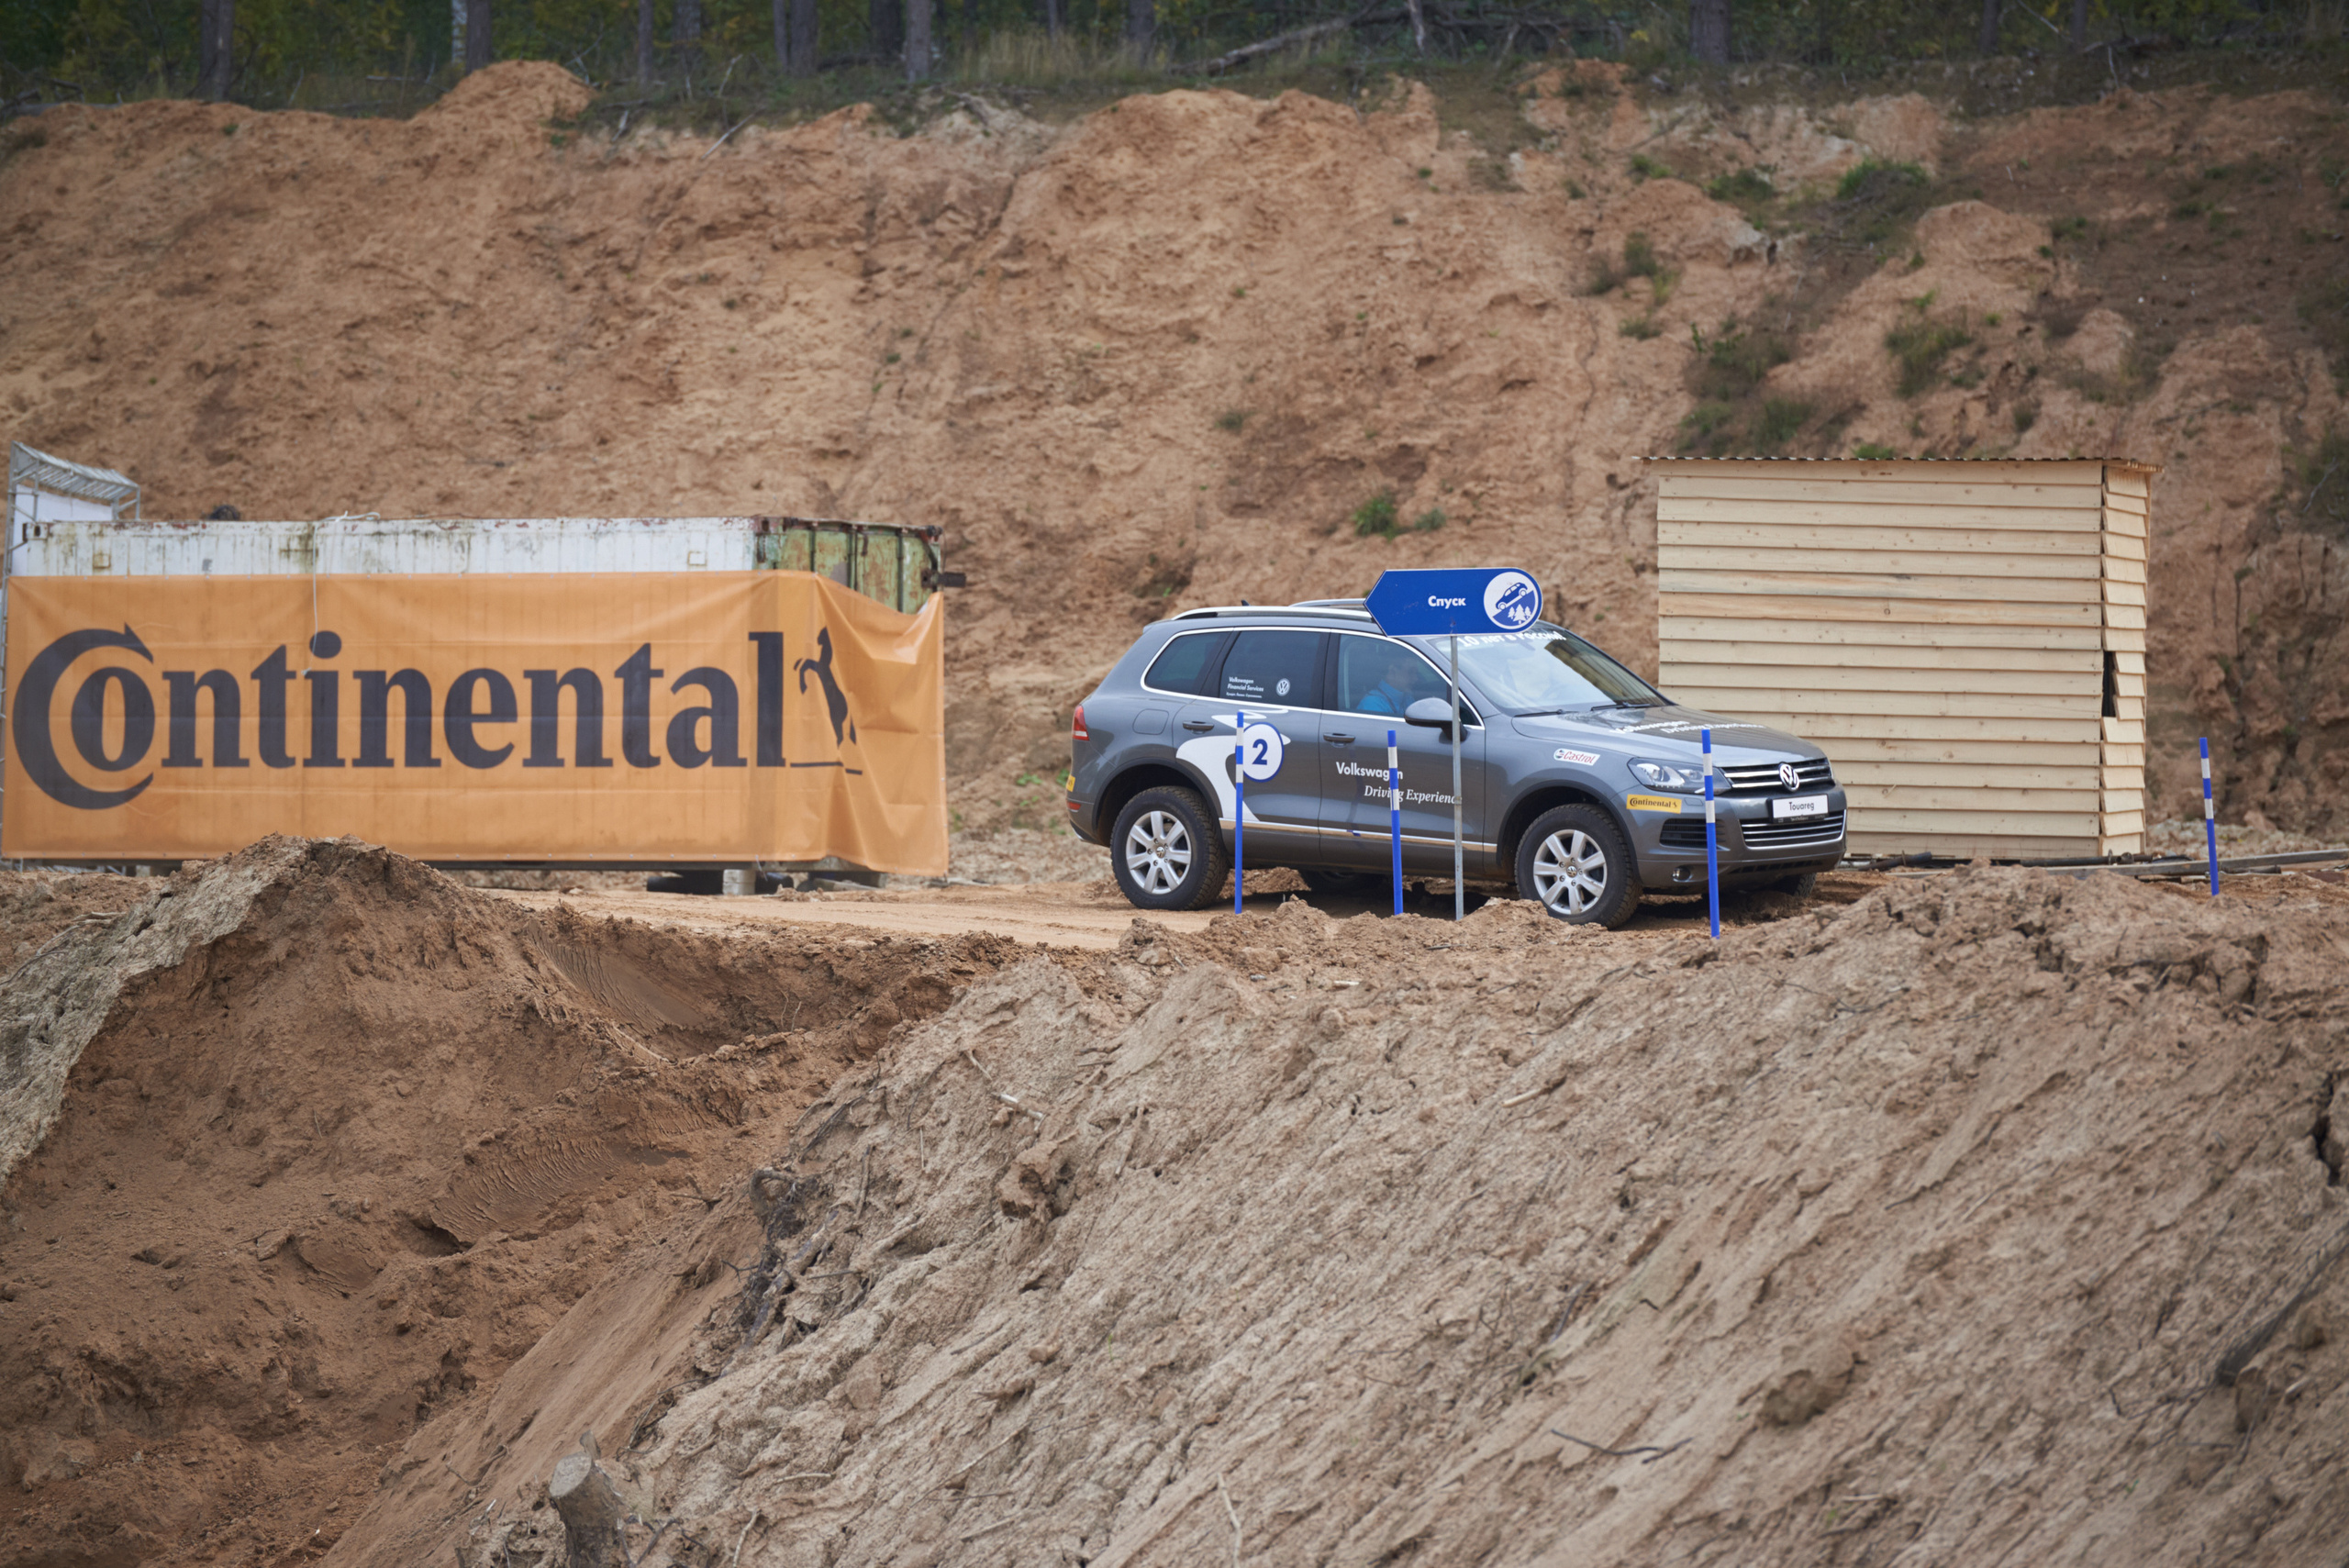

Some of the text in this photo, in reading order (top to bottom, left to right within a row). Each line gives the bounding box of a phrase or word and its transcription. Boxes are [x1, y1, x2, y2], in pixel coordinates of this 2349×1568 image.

[1428, 595, 1466, 609] Спуск
[1457, 635, 1480, 647] 10
[1229, 676, 1254, 684] Volkswagen
[12, 622, 786, 810] Continental
[1252, 738, 1268, 765] 2
[1563, 751, 1597, 763] Castrol
[1335, 762, 1404, 782] Volkswagn
[1364, 784, 1462, 805] Drivig Experienc
[1629, 797, 1672, 808] Continental
[1788, 801, 1815, 812] Touareg
